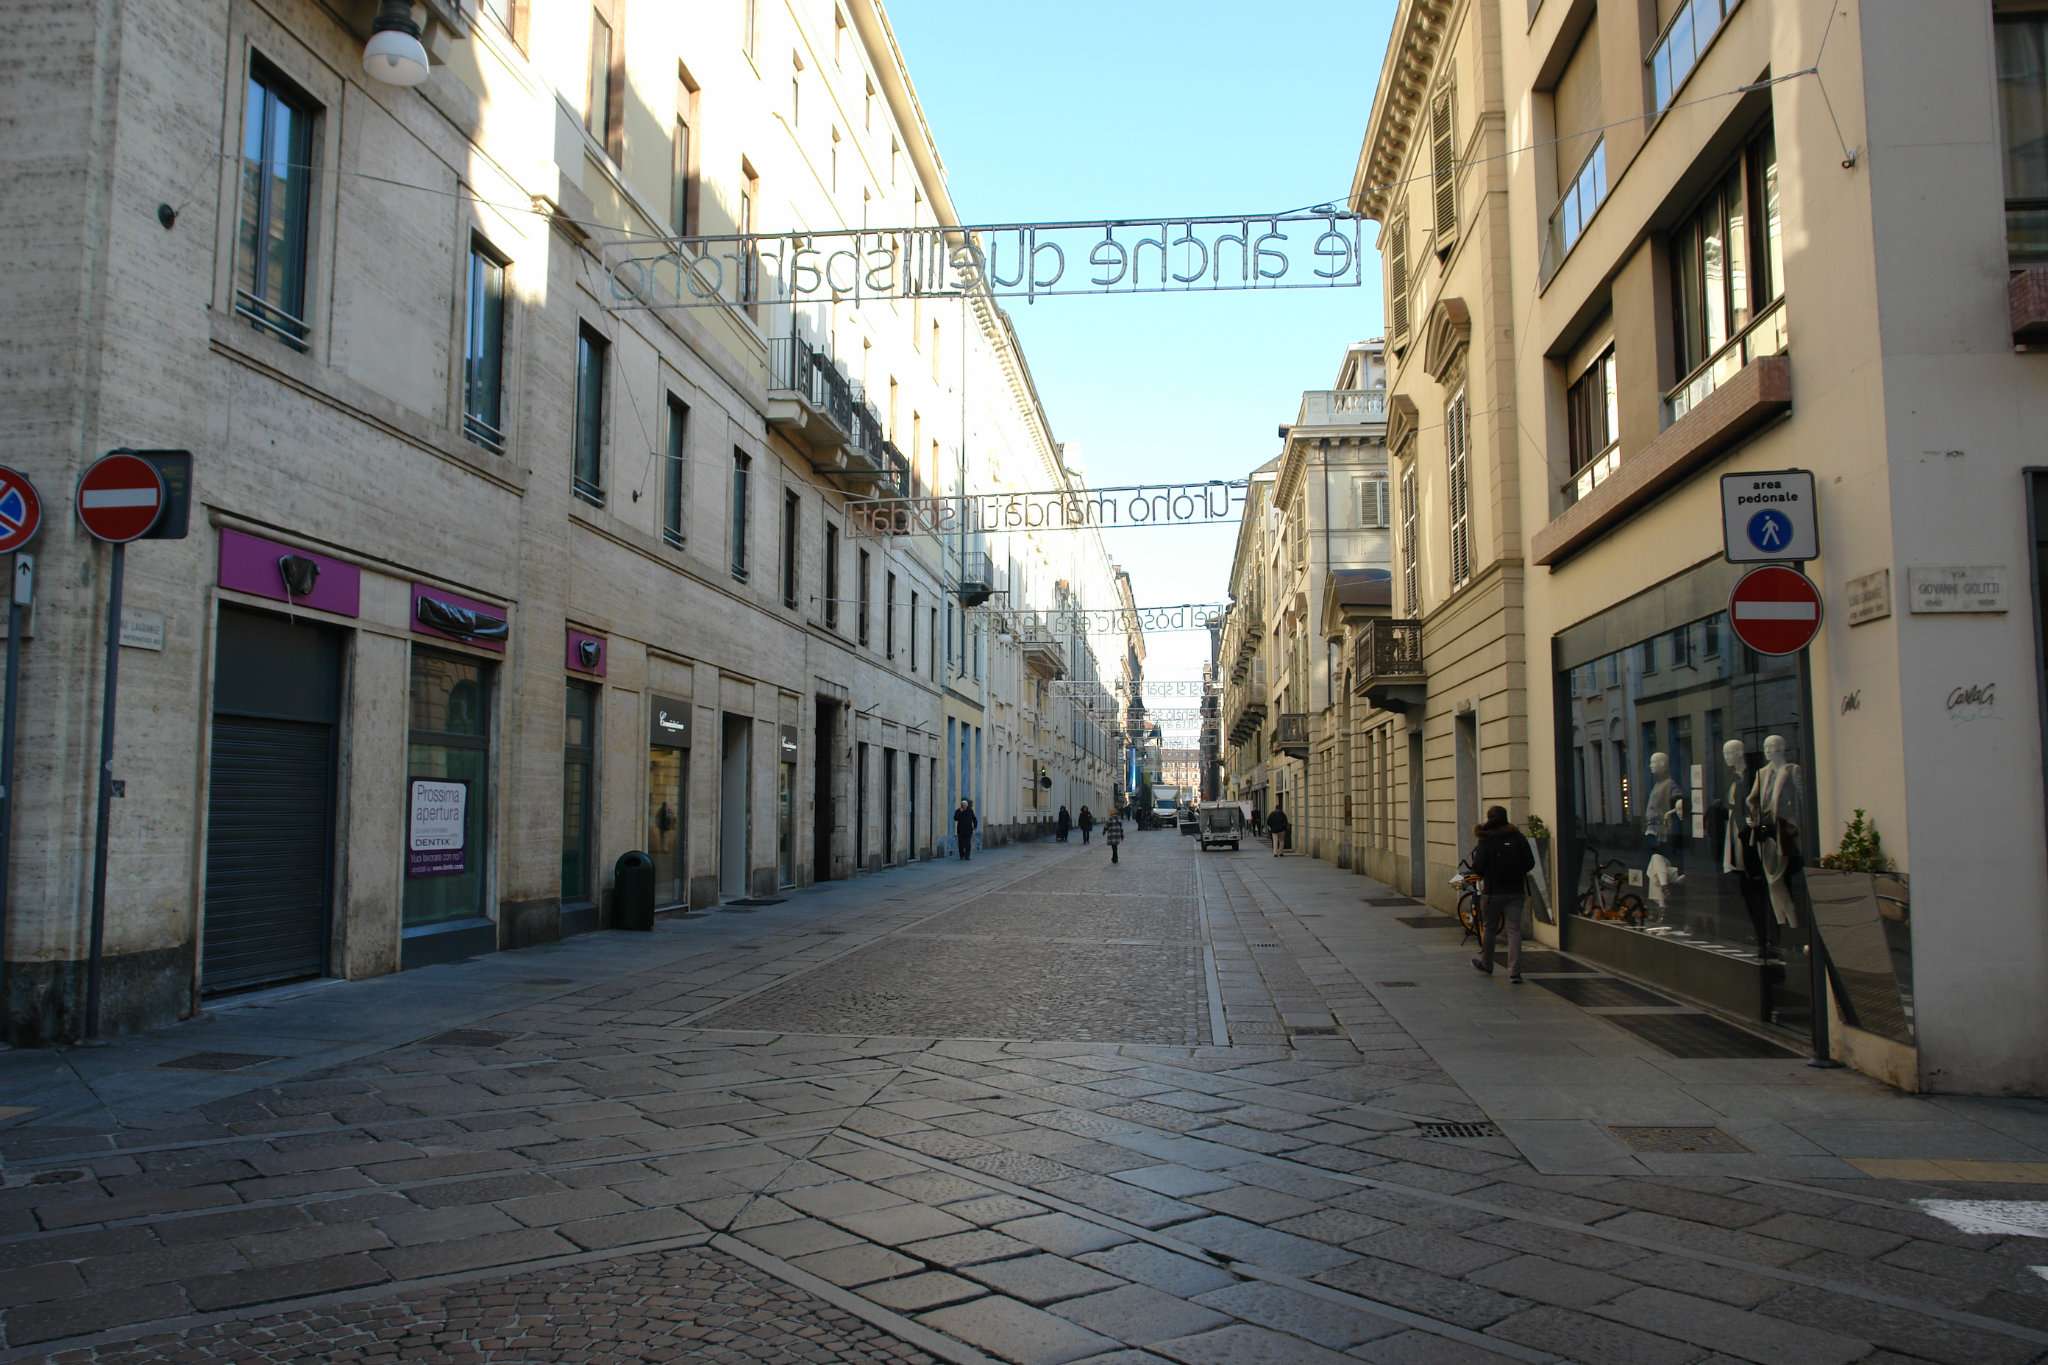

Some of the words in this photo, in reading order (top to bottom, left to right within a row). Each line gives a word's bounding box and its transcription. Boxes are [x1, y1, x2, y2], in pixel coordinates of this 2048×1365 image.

[1753, 481, 1782, 490] area
[1738, 492, 1799, 505] pedonale
[1918, 583, 1958, 595] GIOVANNI
[1963, 582, 2000, 594] GIOLITTI
[417, 785, 460, 803] Prossima
[416, 807, 460, 824] apertura
[416, 838, 450, 847] DENTIX
